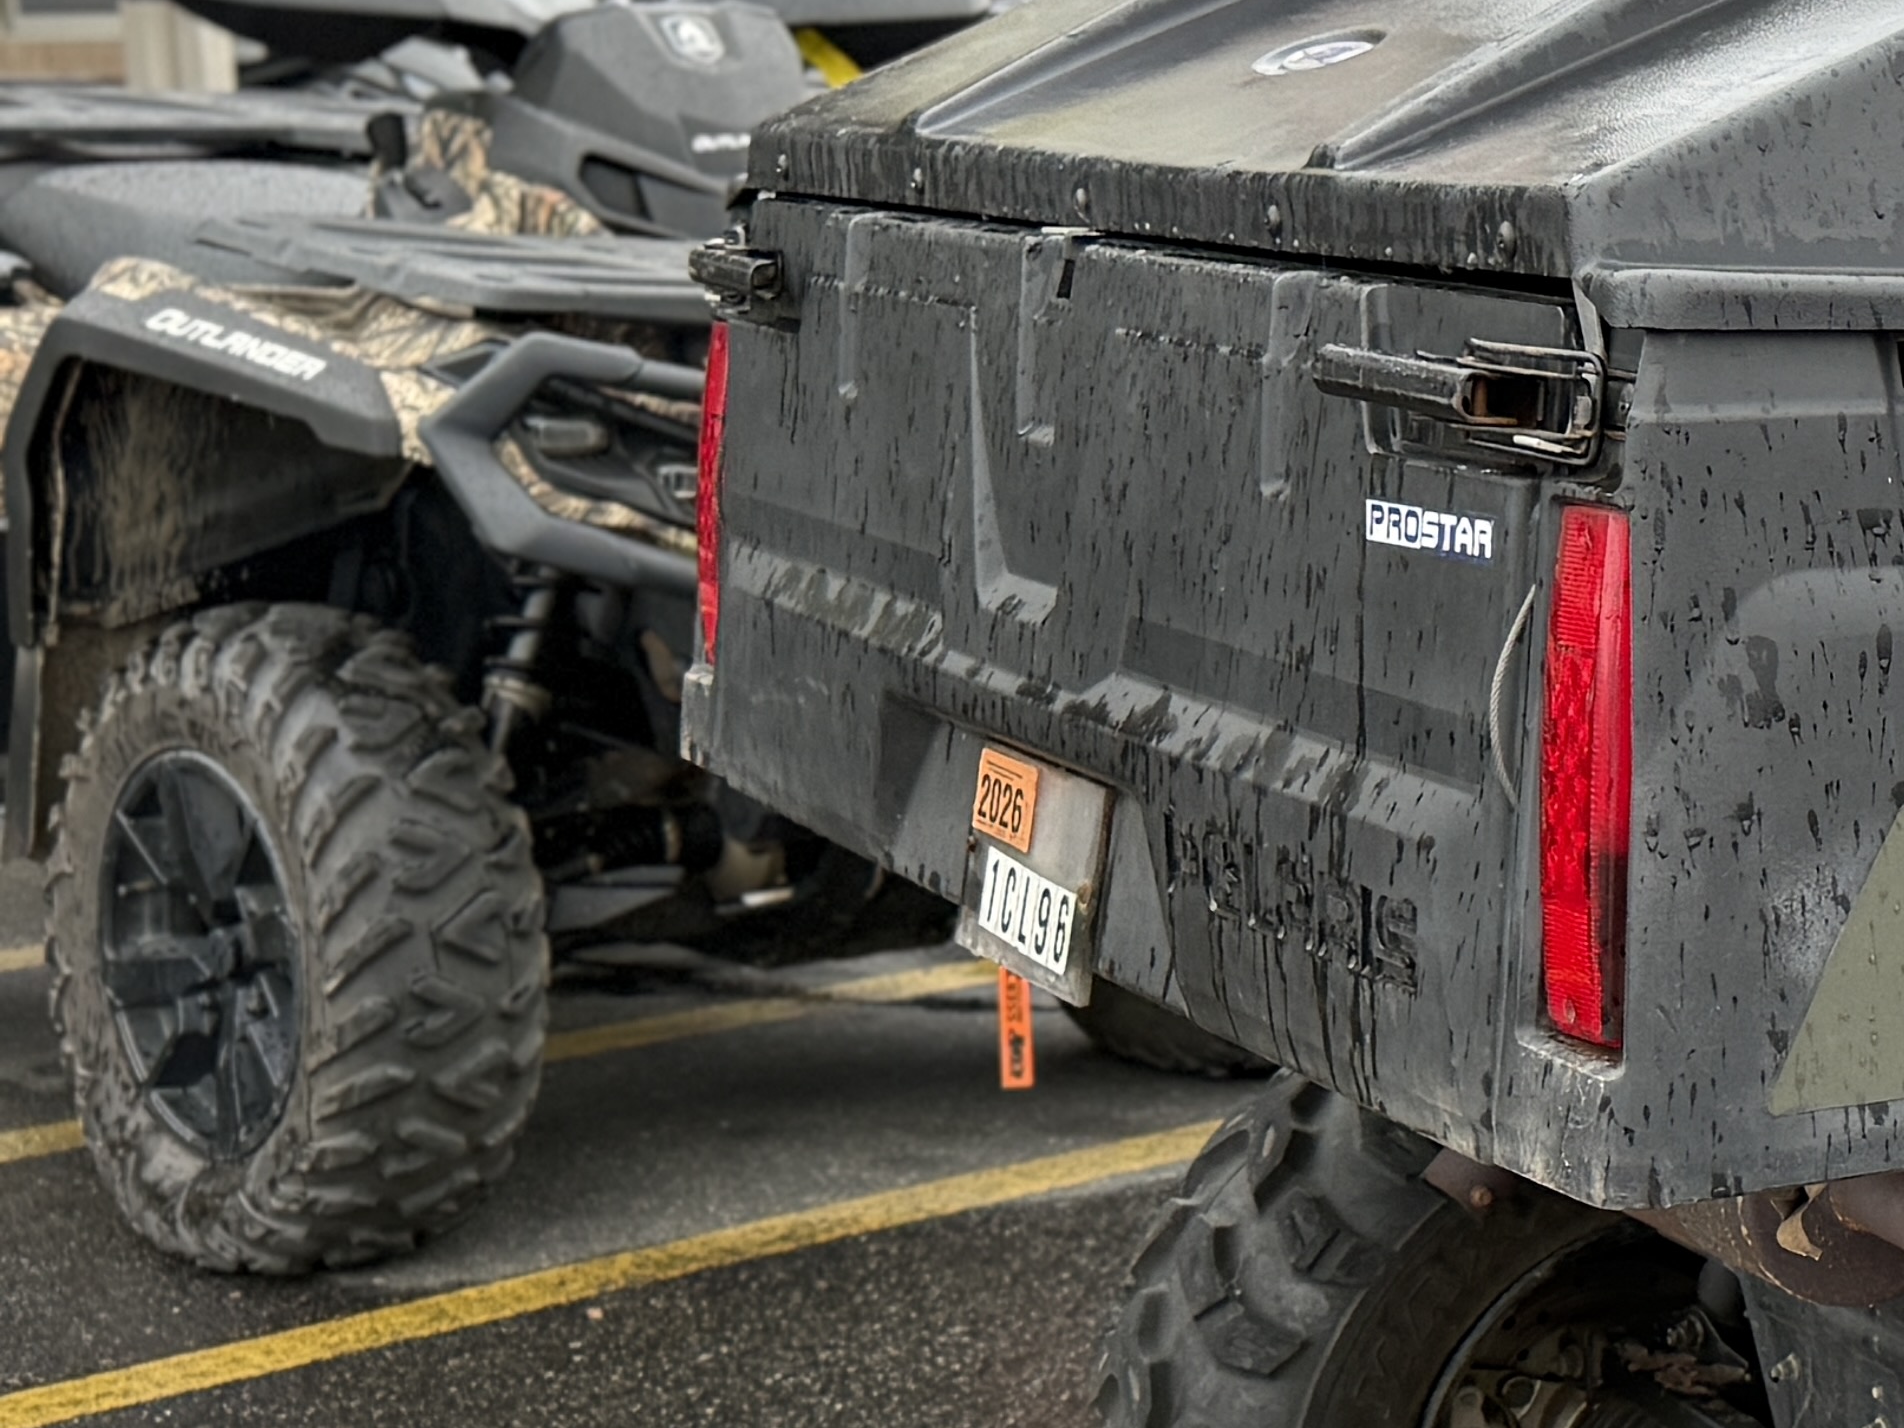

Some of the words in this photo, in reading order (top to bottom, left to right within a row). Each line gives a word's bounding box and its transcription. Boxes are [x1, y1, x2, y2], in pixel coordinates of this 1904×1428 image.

[144, 307, 328, 381] OUTLANDER
[1366, 499, 1494, 559] PROSTAR
[978, 774, 1025, 834] 2026
[986, 858, 1071, 965] 1CL96
